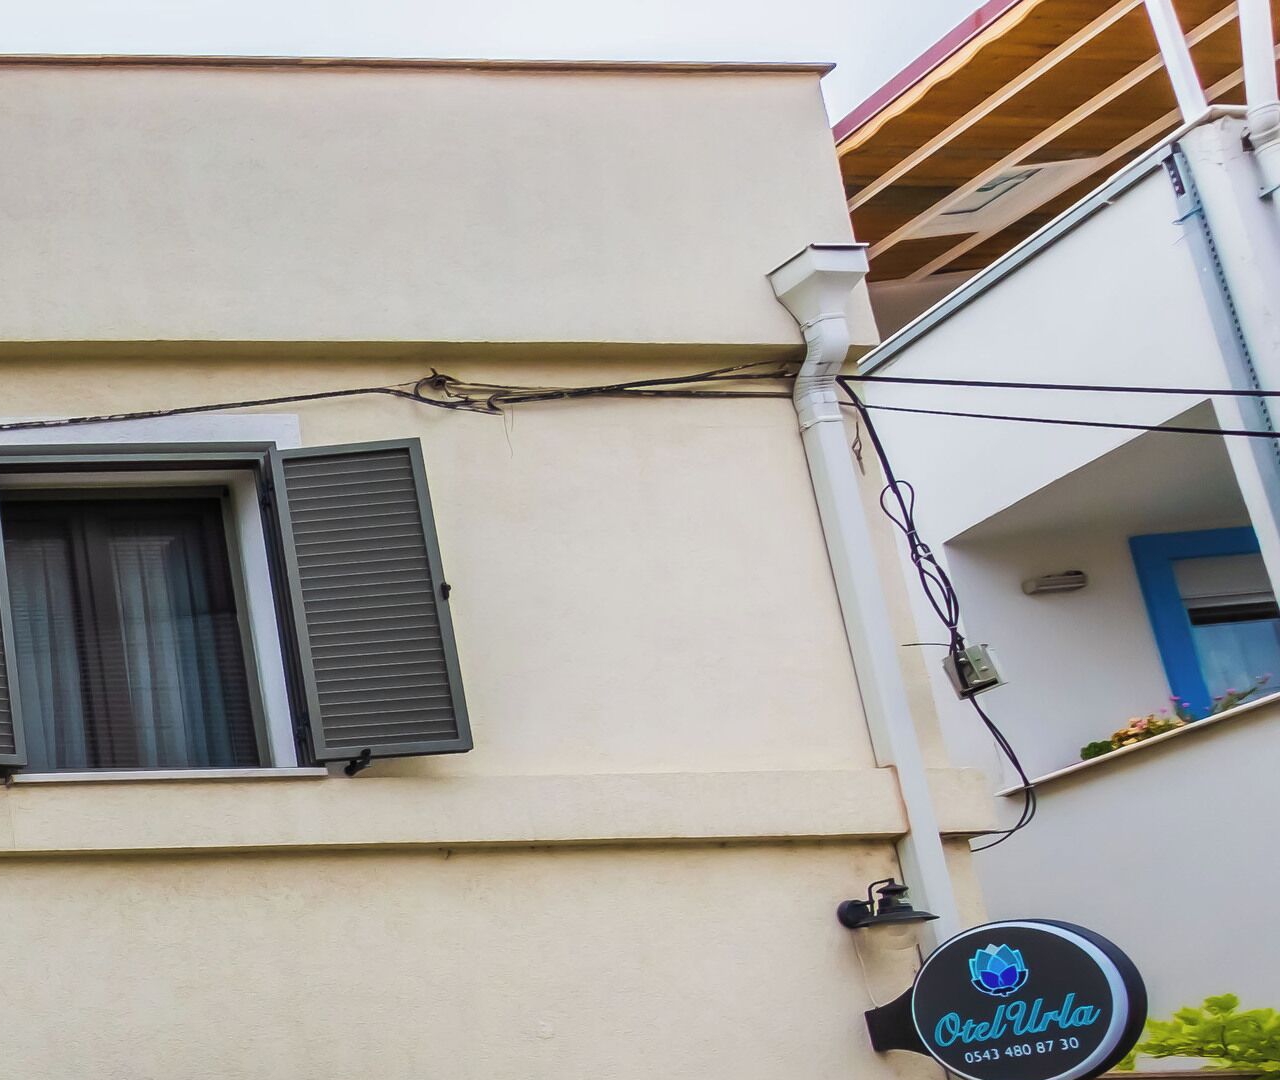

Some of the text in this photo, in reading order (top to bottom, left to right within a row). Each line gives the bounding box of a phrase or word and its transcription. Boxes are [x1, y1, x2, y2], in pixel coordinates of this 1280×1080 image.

[964, 1036, 1080, 1064] 0543 480 87 30
